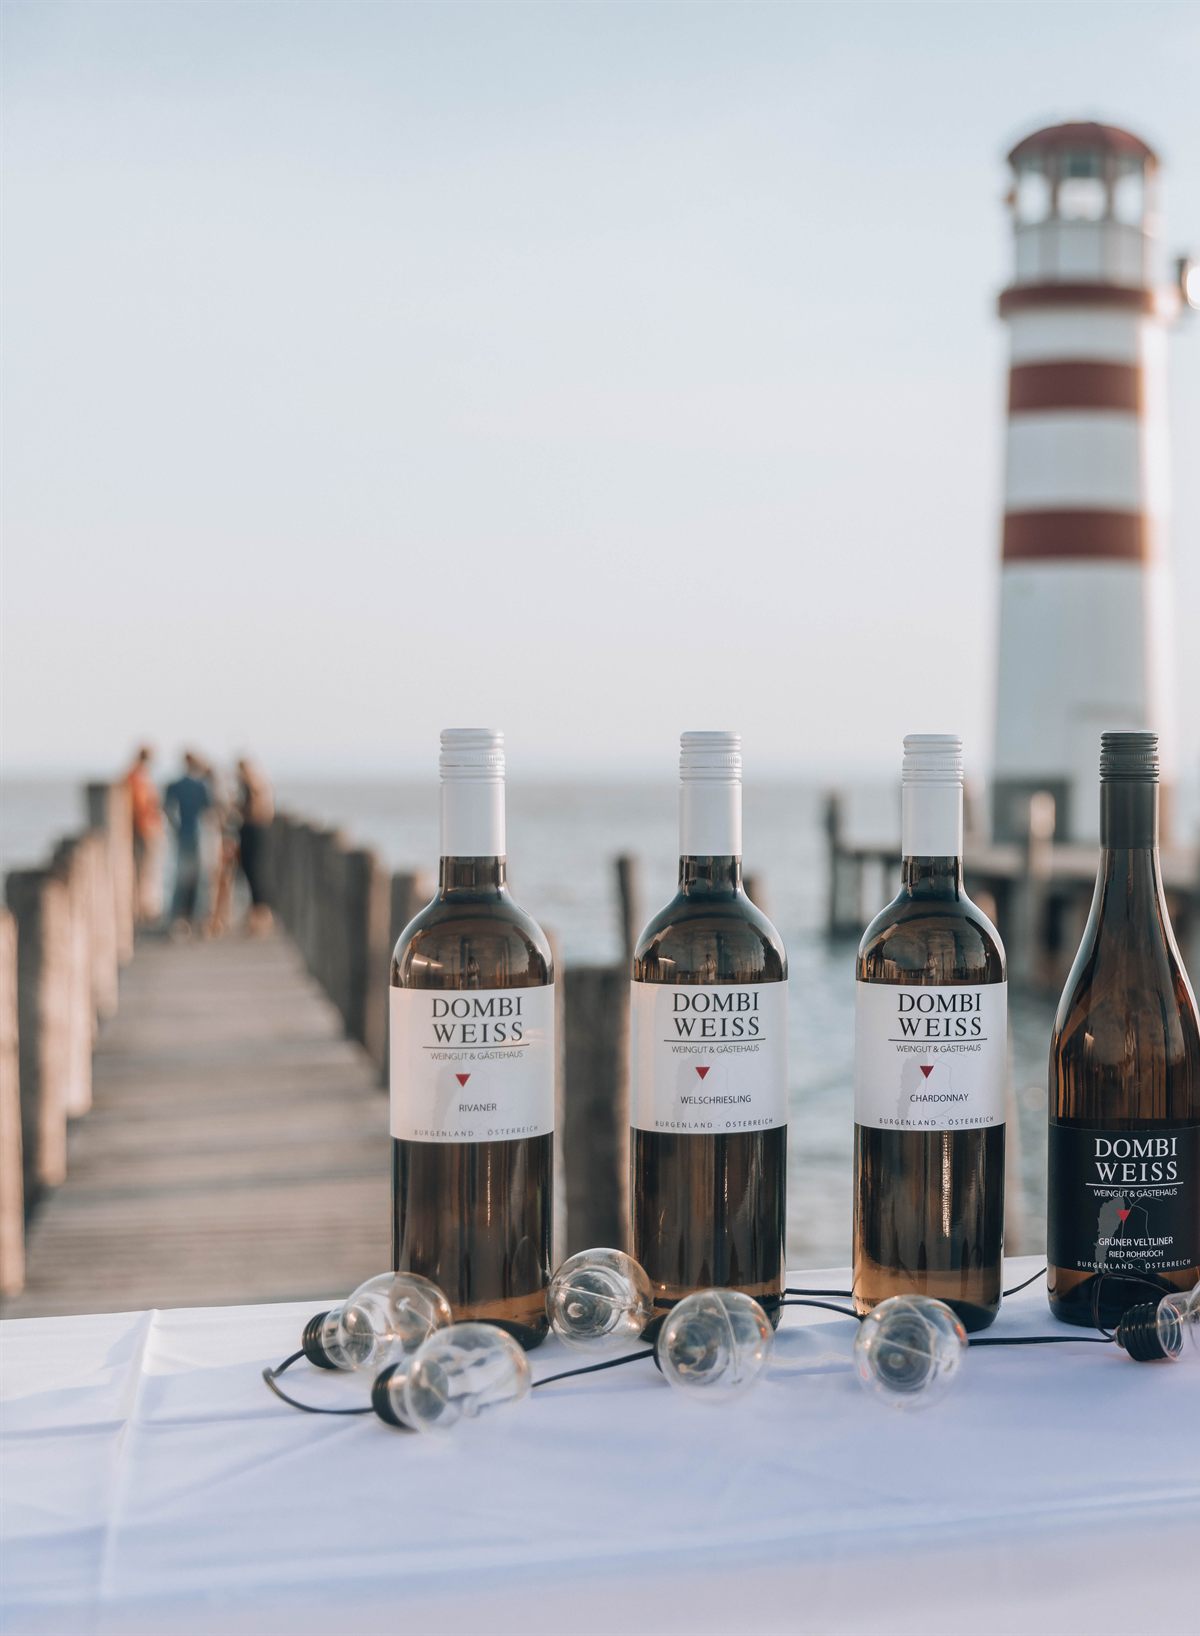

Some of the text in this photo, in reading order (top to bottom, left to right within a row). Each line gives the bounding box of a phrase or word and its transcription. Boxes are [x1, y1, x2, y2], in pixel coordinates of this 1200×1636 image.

[432, 996, 522, 1019] DOMBI
[673, 992, 759, 1013] DOMBI
[897, 993, 982, 1013] DOMBI
[673, 1016, 760, 1037] WEISS
[898, 1016, 981, 1037] WEISS
[432, 1021, 523, 1044] WEISS
[672, 1045, 708, 1054] WEINGUT
[716, 1044, 760, 1054] GÄSTEHAUS
[896, 1044, 981, 1053] WEINGUT & GÄSTEHAUS
[431, 1052, 469, 1061] WEINGUT
[478, 1050, 524, 1061] GÄSTEHAUS
[680, 1094, 752, 1105] WELSCHRIESLING
[909, 1093, 969, 1103] CHARDONNAY
[458, 1103, 497, 1113] RIVANER
[655, 1120, 713, 1129] BURGENLAND
[725, 1118, 773, 1128] ÖSTERREICH
[879, 1117, 936, 1126] BURGENLAND
[948, 1115, 994, 1126] ÖSTERREICH
[414, 1129, 474, 1137] BURGENLAND
[487, 1125, 539, 1136] ÖSTERREICH
[1094, 1137, 1178, 1158] DOMBI
[1095, 1161, 1177, 1182] WEISS
[1093, 1187, 1178, 1198] WEINGUT & GÄSTEHAUS
[1098, 1236, 1174, 1246] GRÜNER VELTLINER
[1109, 1250, 1164, 1258] RIED ROHRJOCH
[1077, 1260, 1134, 1270] BURGENLAND
[1145, 1258, 1191, 1269] ÖSTERREICH
